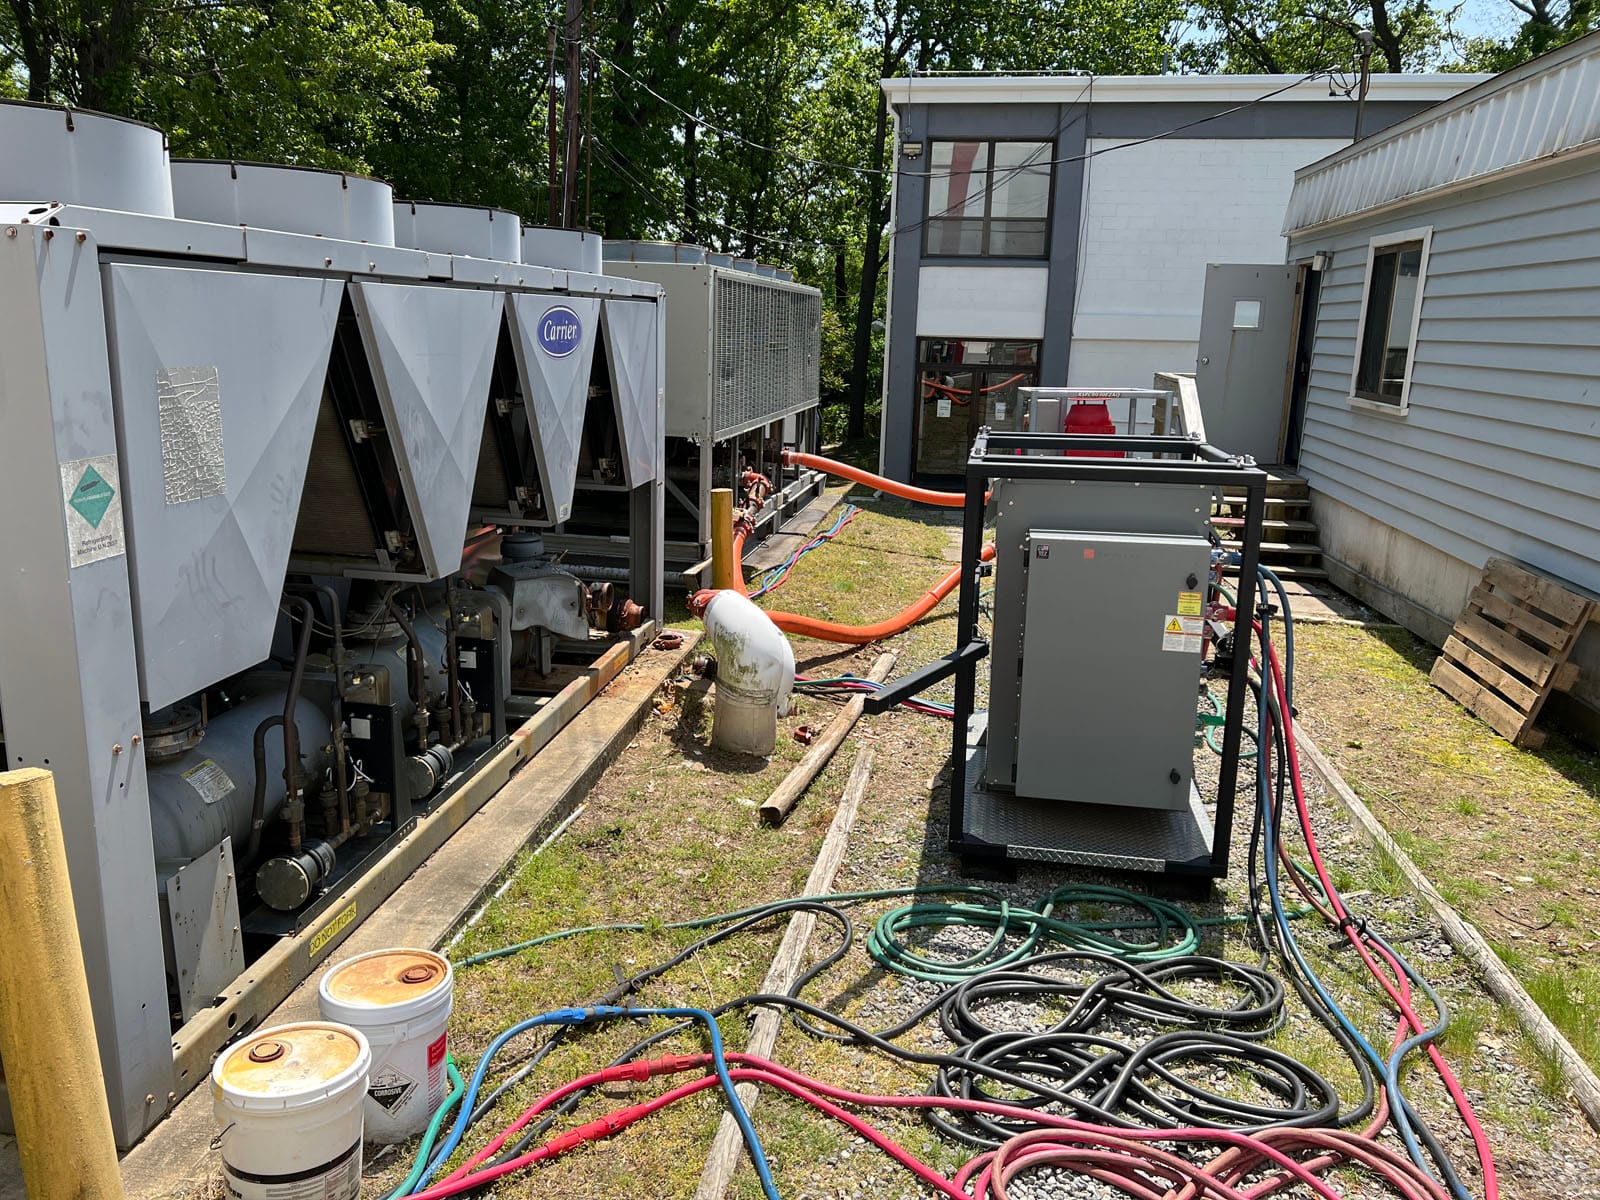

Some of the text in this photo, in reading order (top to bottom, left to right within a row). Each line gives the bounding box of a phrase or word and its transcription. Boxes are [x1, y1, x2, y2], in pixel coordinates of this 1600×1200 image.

[544, 319, 577, 342] Carrier
[322, 920, 337, 943] NOT
[374, 1086, 402, 1097] CORROSIVE
